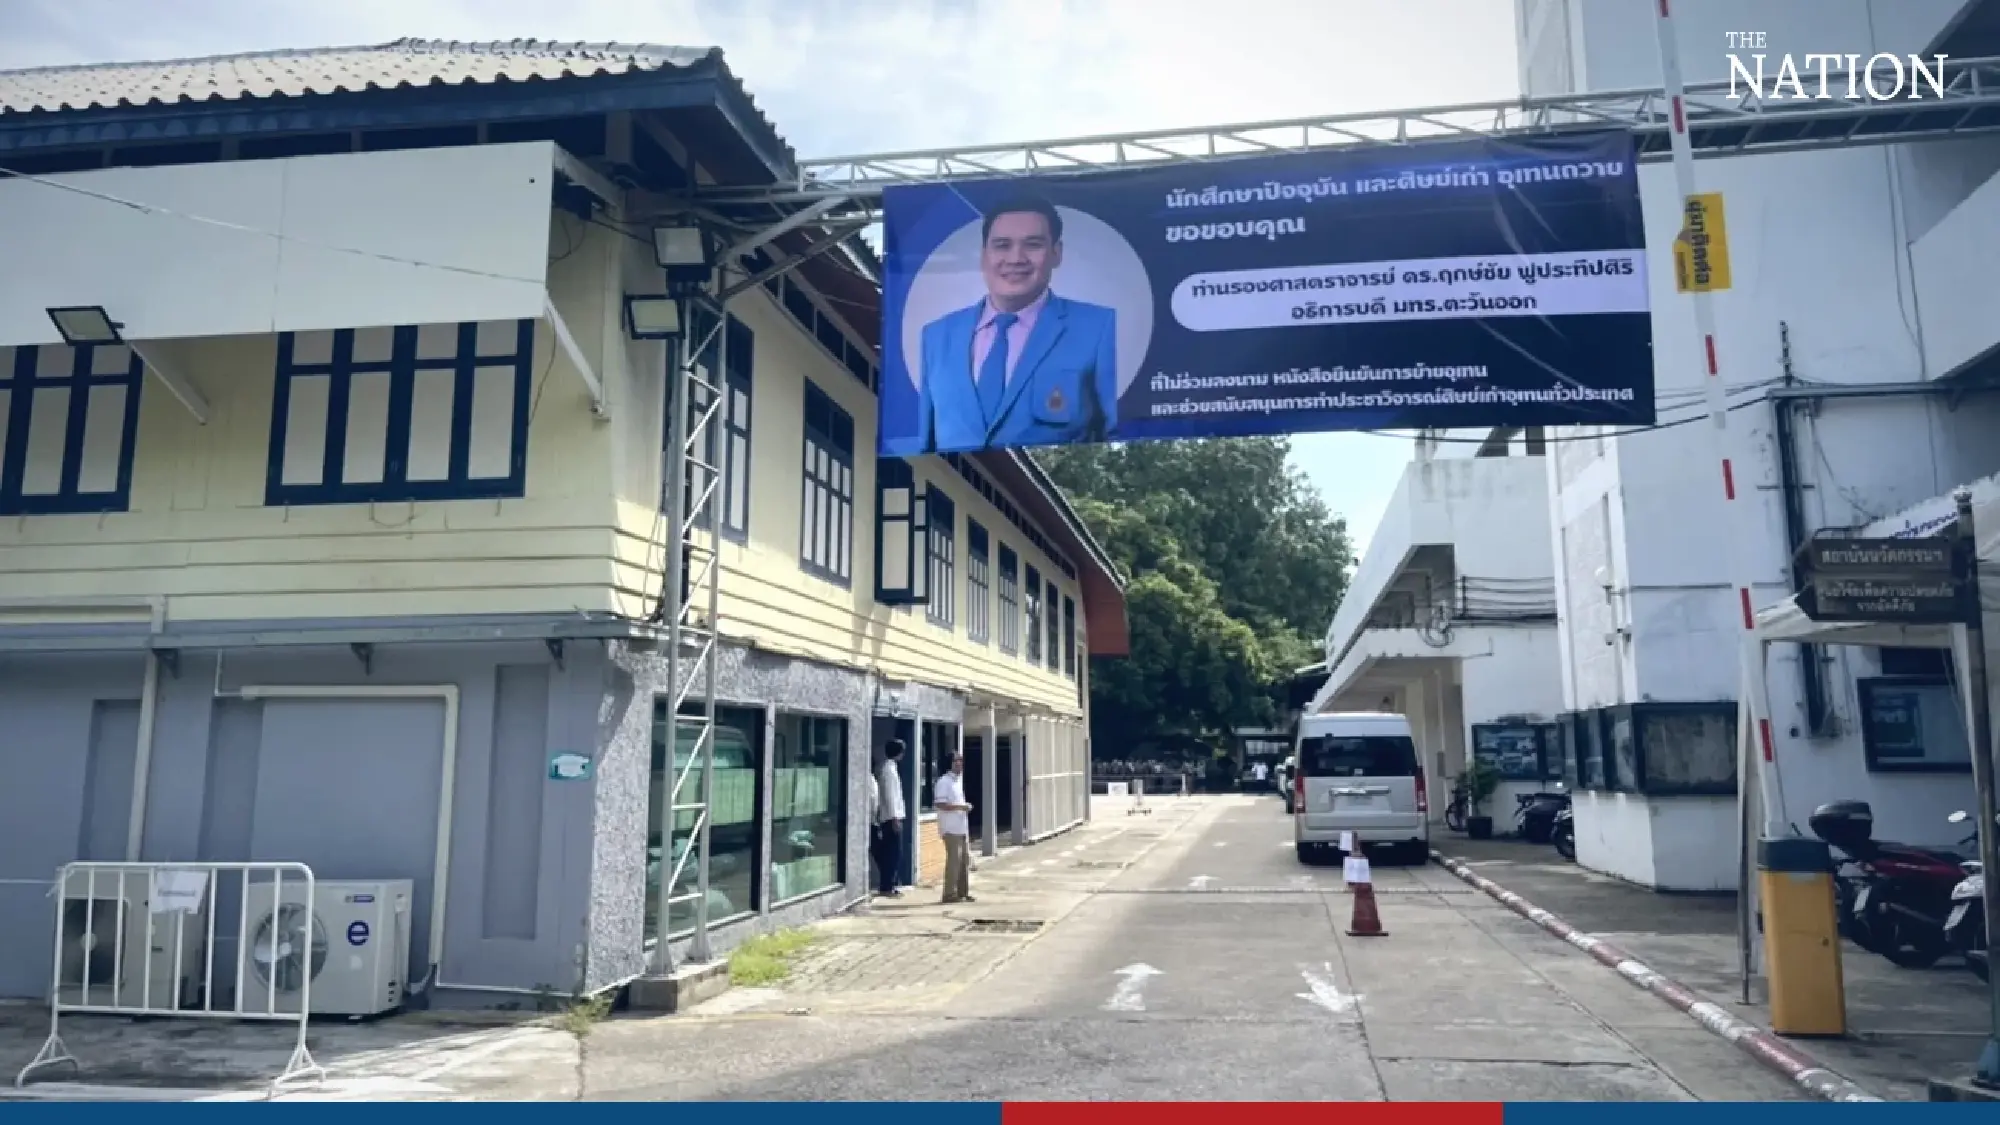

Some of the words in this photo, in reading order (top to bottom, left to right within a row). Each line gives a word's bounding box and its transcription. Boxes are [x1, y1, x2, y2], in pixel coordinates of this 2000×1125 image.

[1166, 177, 1348, 208] นักศึกษาปัจจุบัน
[1356, 165, 1489, 193] และศิษย์เก่า
[1498, 161, 1623, 189] อุเทนถวาย
[1166, 217, 1306, 242] ขอขอบคุณ
[1192, 266, 1396, 298] ท่านรองศาสตราจารย์
[1402, 262, 1511, 285] ดร.ฤกษ์ชัย
[1291, 296, 1386, 319] อธิการบดี
[1394, 292, 1537, 313] มทร.ตะวันออก
[1151, 371, 1269, 391] ที่ไม่ร่วมลงนาม
